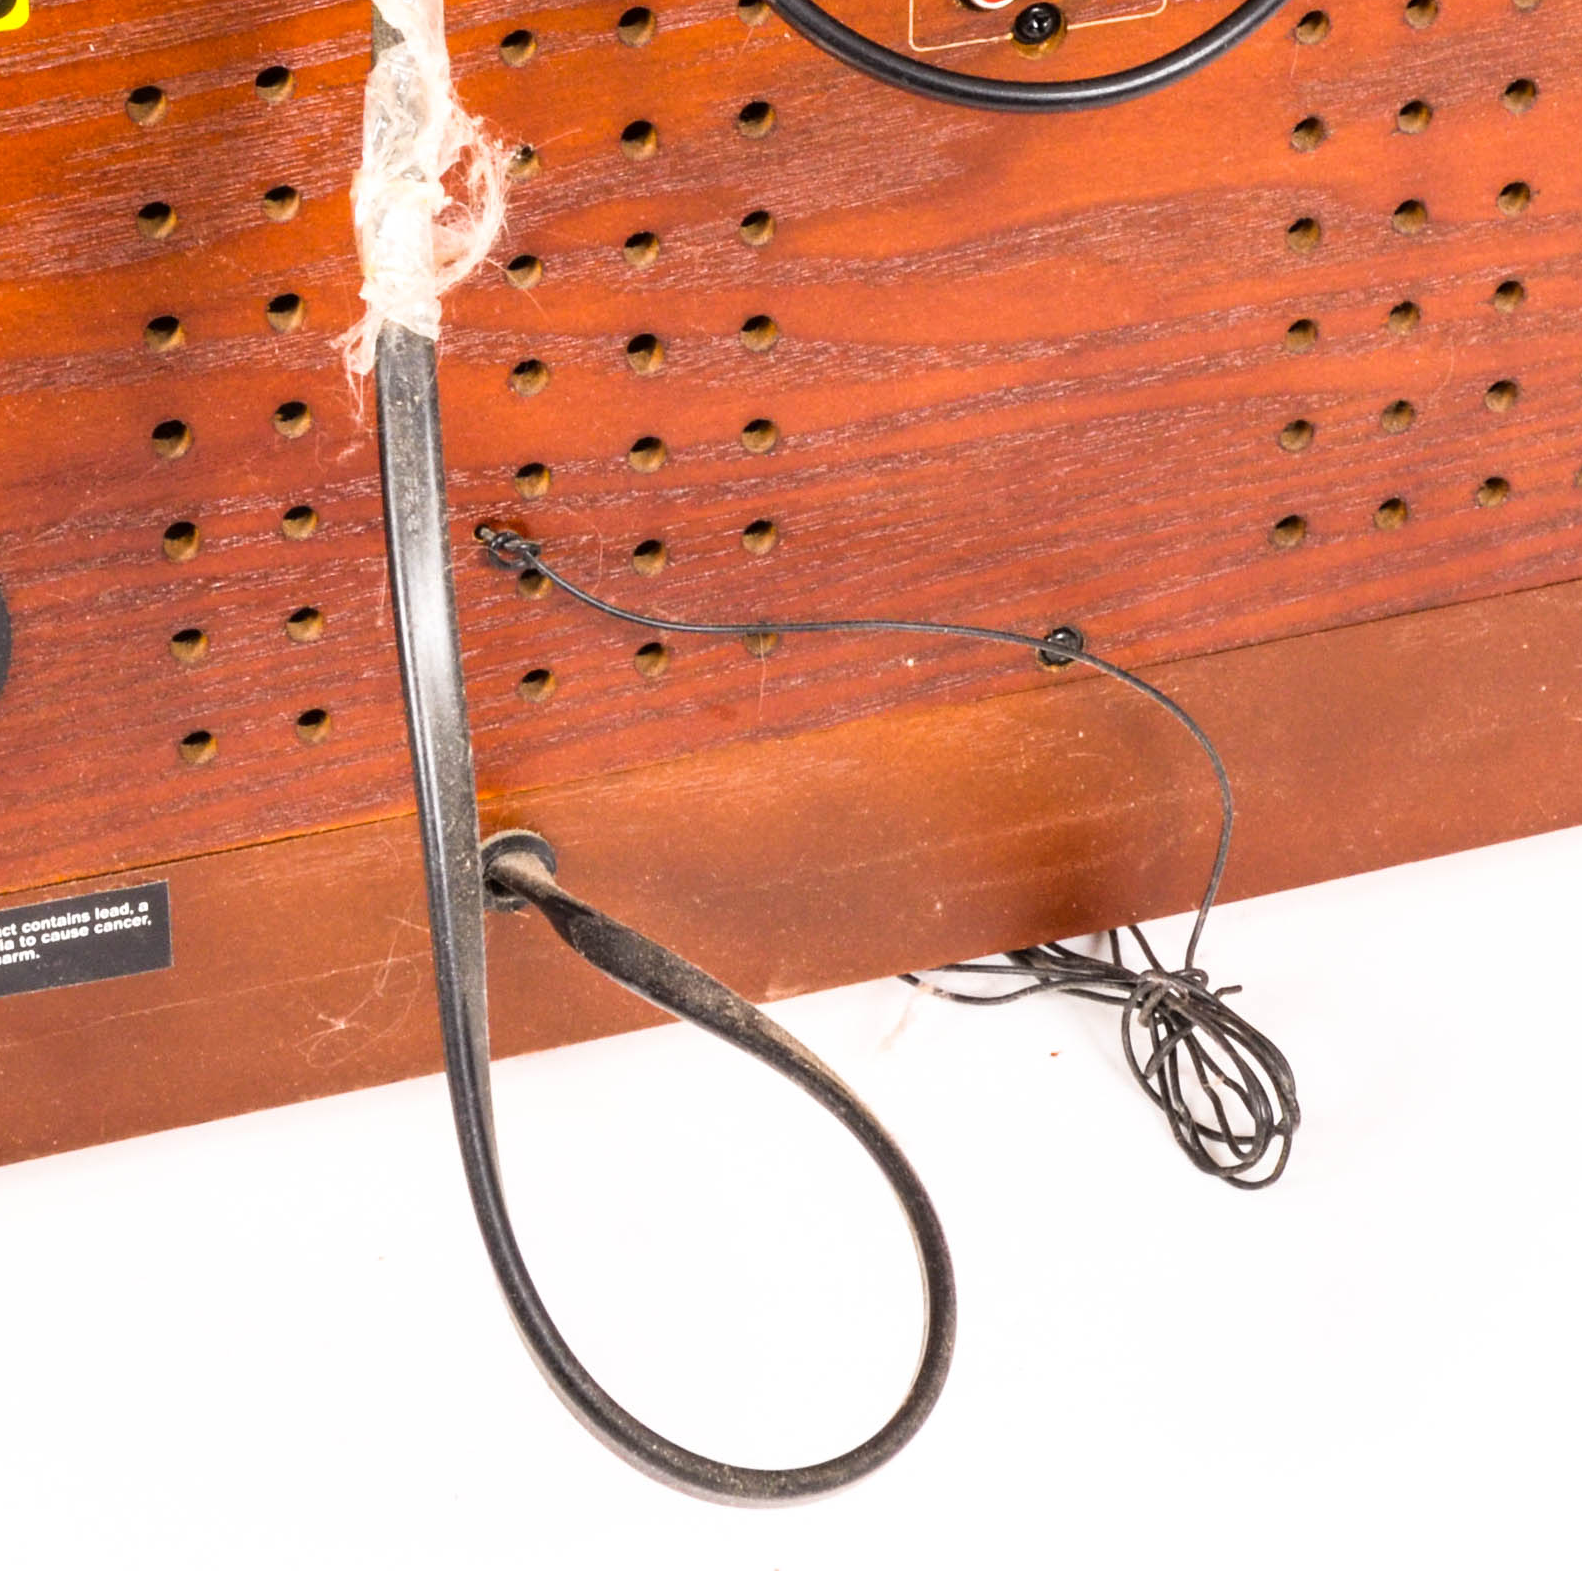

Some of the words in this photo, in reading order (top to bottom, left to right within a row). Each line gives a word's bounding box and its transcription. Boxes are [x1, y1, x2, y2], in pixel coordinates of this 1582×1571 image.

[21, 911, 91, 934] contains
[18, 935, 37, 948] to
[40, 925, 90, 944] cause
